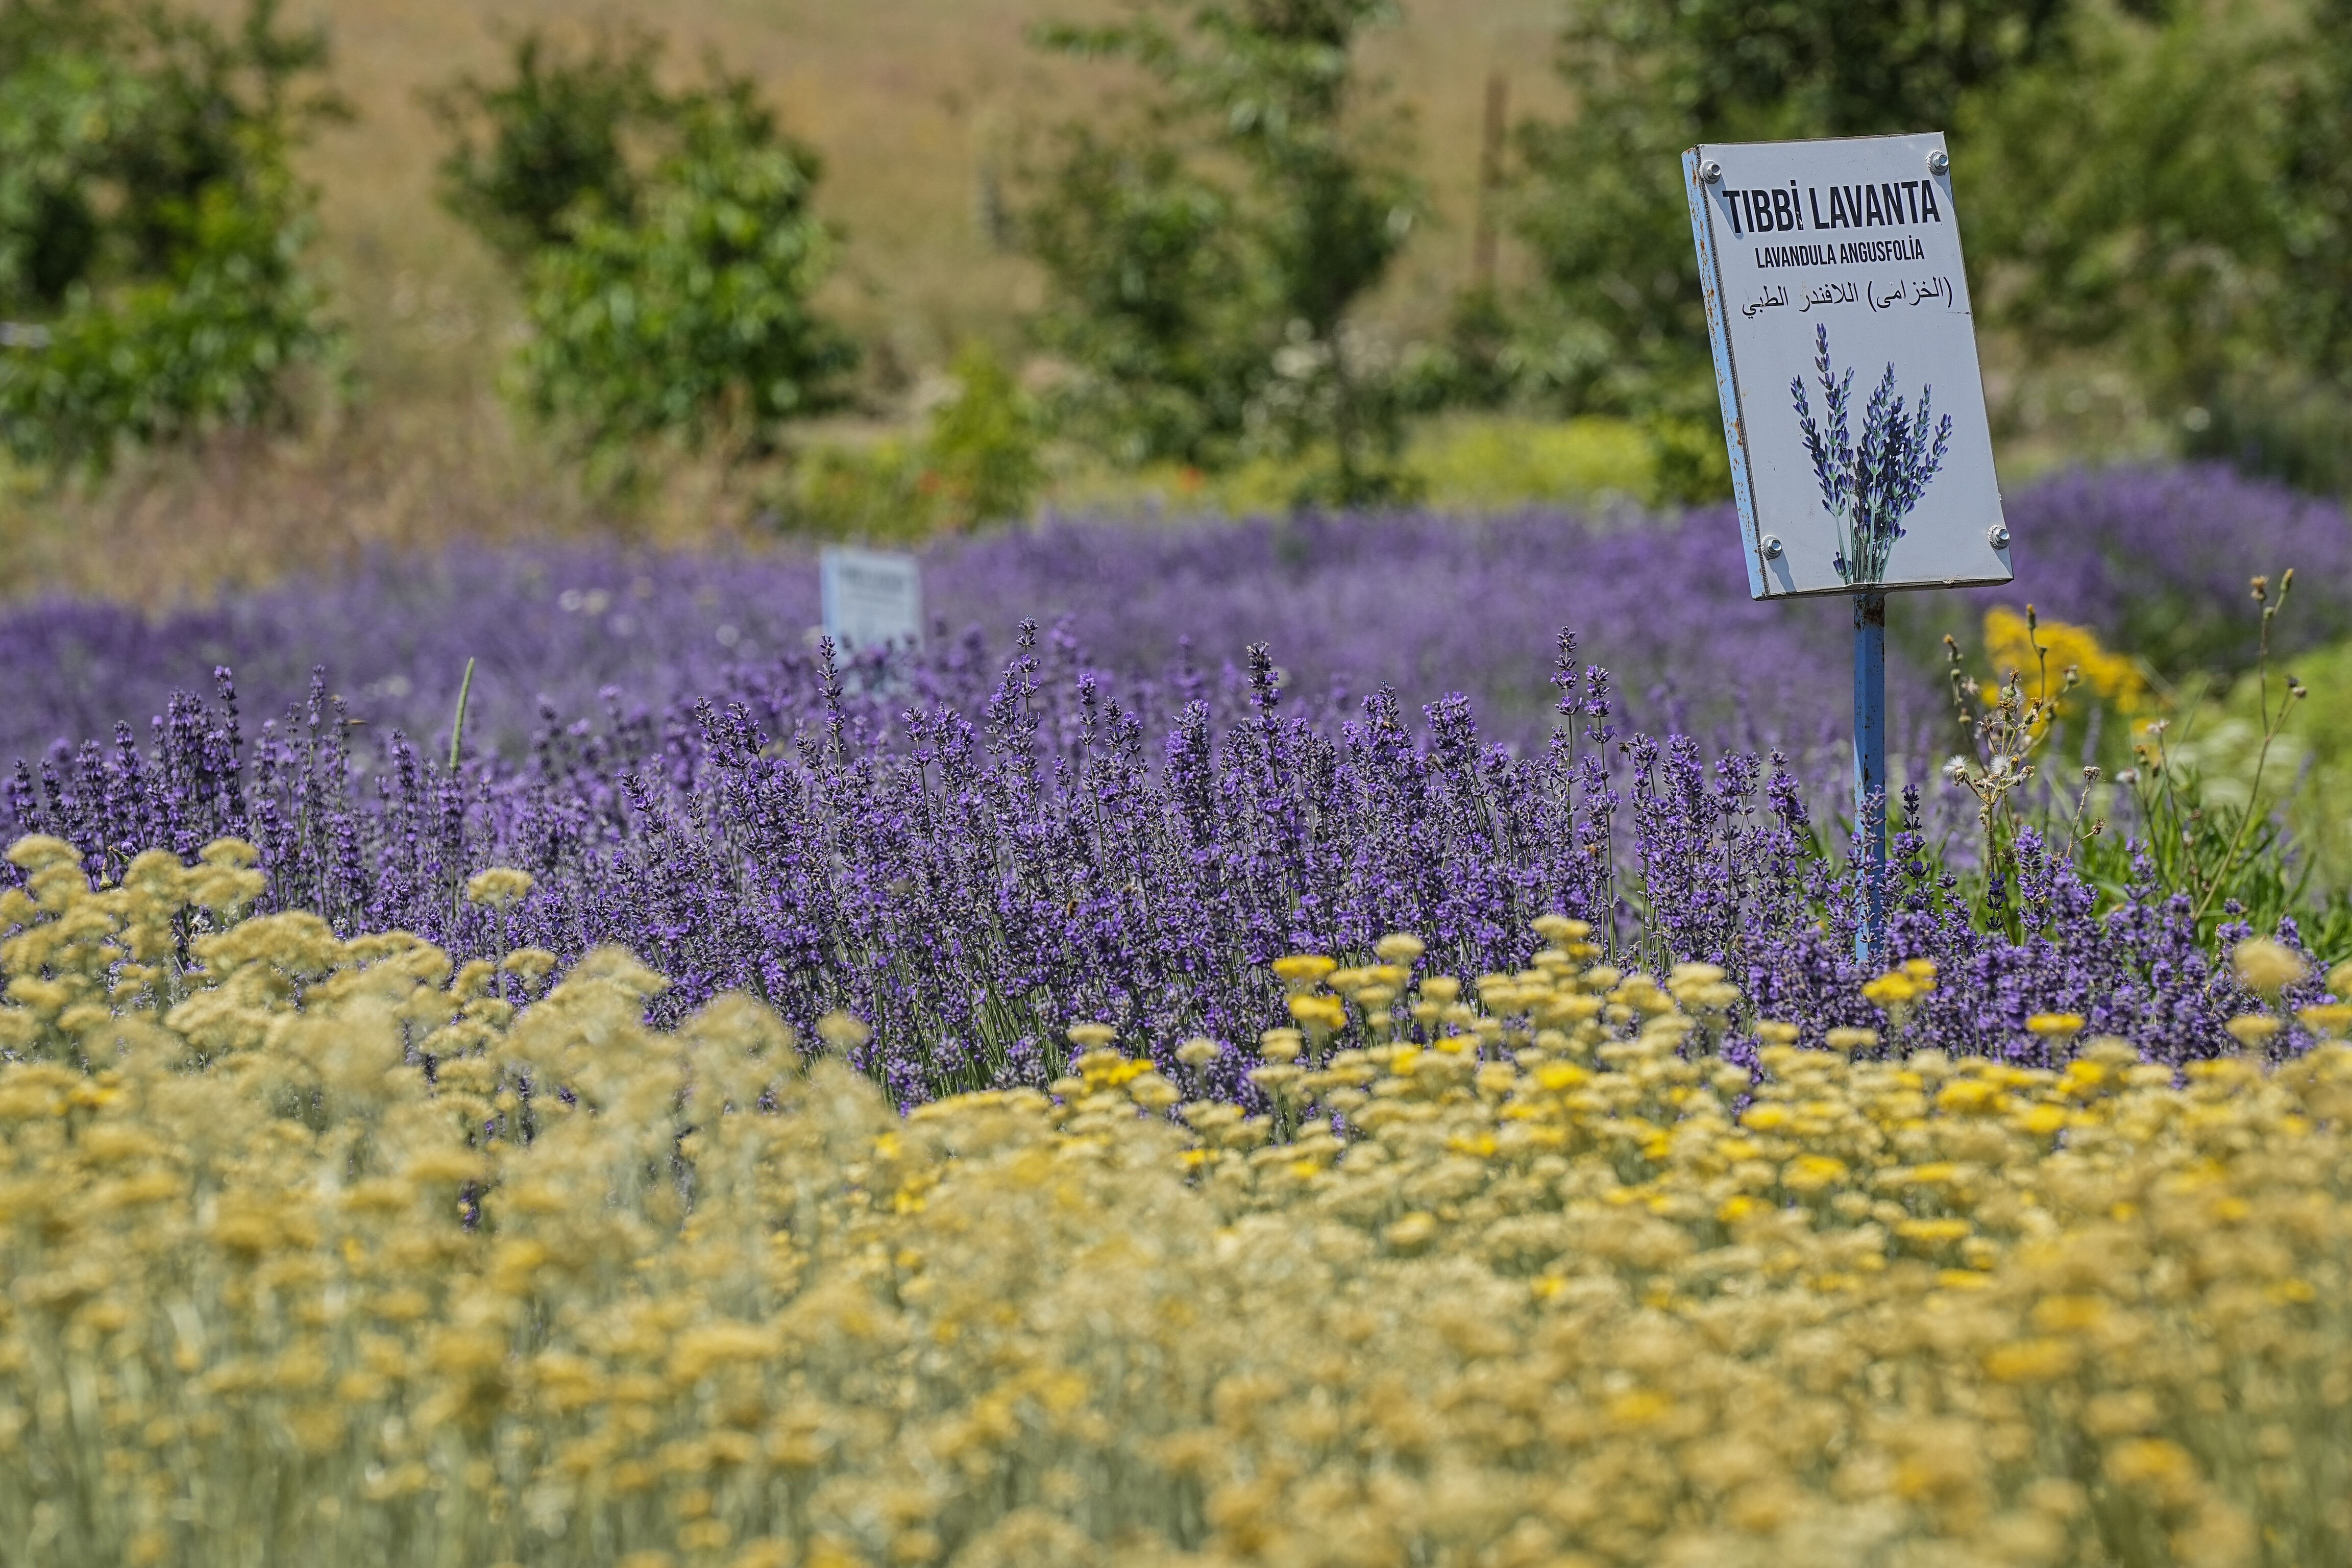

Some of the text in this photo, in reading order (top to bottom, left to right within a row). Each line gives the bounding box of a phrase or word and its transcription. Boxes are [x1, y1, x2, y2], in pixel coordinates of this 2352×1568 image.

[1722, 179, 1941, 234] TIBBİ LAVANTA
[1755, 235, 1925, 268] LAVANDULA ANGUSFOLİA
[1742, 276, 1952, 320] (الخزامى) اللافندر الطبي
